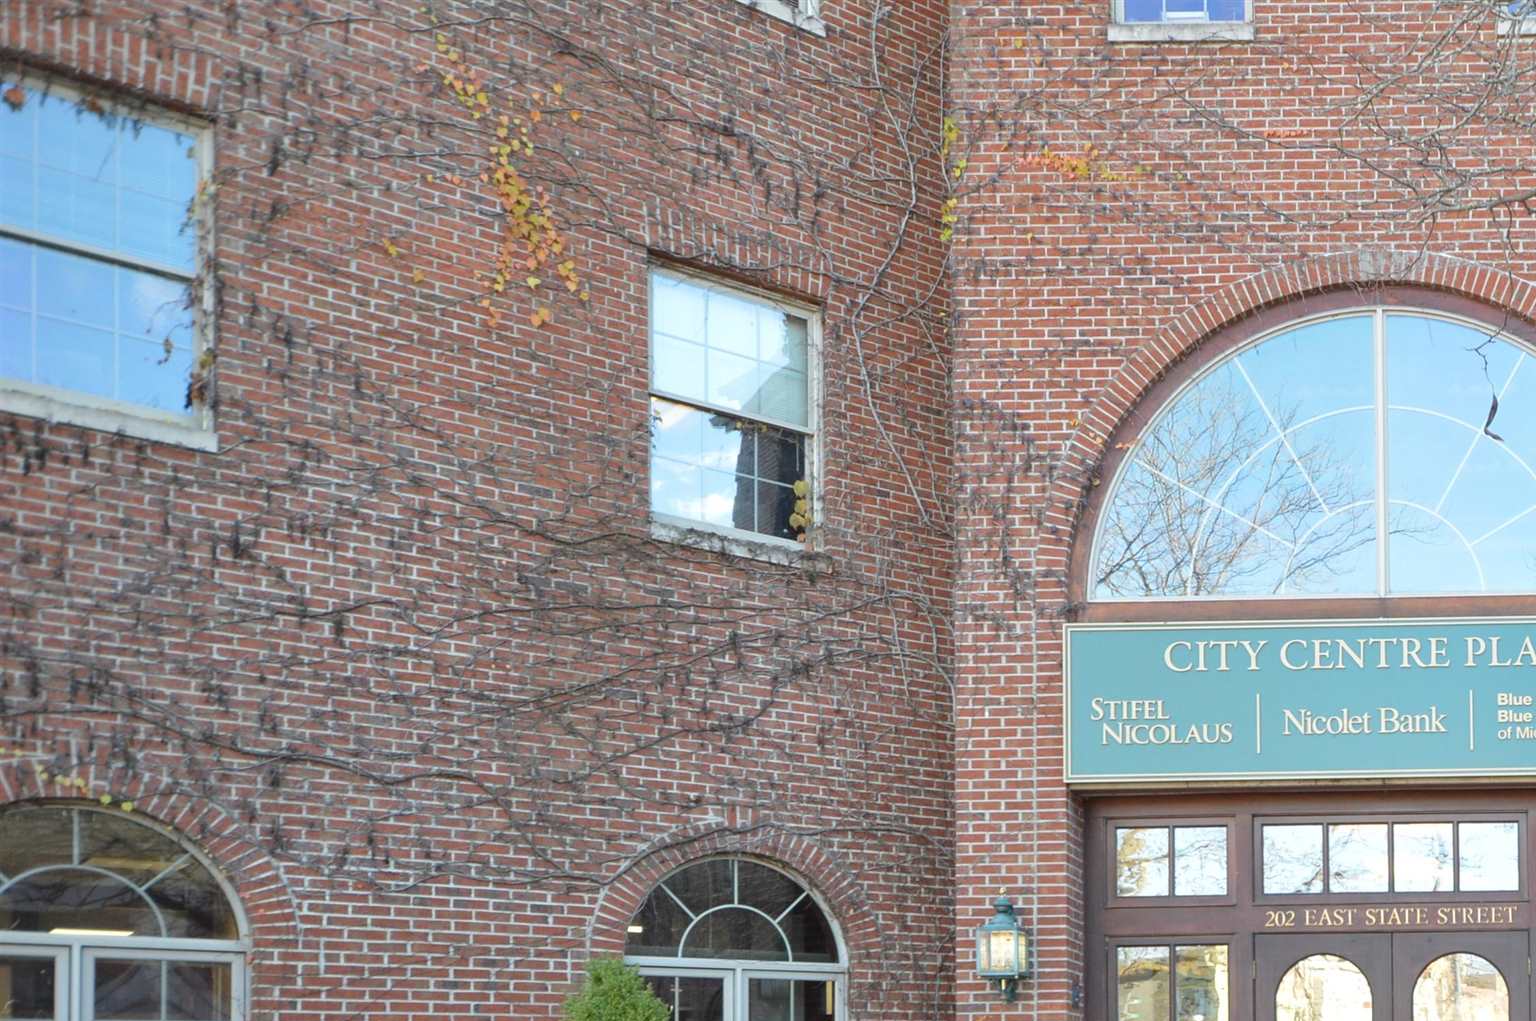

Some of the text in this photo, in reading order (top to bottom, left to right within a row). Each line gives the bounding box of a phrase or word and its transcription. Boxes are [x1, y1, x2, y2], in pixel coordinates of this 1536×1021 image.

[1163, 639, 1268, 672] CITY
[1279, 636, 1451, 670] CENTRE
[1090, 697, 1170, 721] STIFEL
[1497, 692, 1534, 706] Blue
[1282, 705, 1448, 735] Nicolet Bank
[1497, 709, 1534, 723] Blue
[1102, 722, 1233, 745] NICOLAUS
[1497, 725, 1513, 740] of
[1264, 906, 1518, 928] 202 EAST STATE STREET
